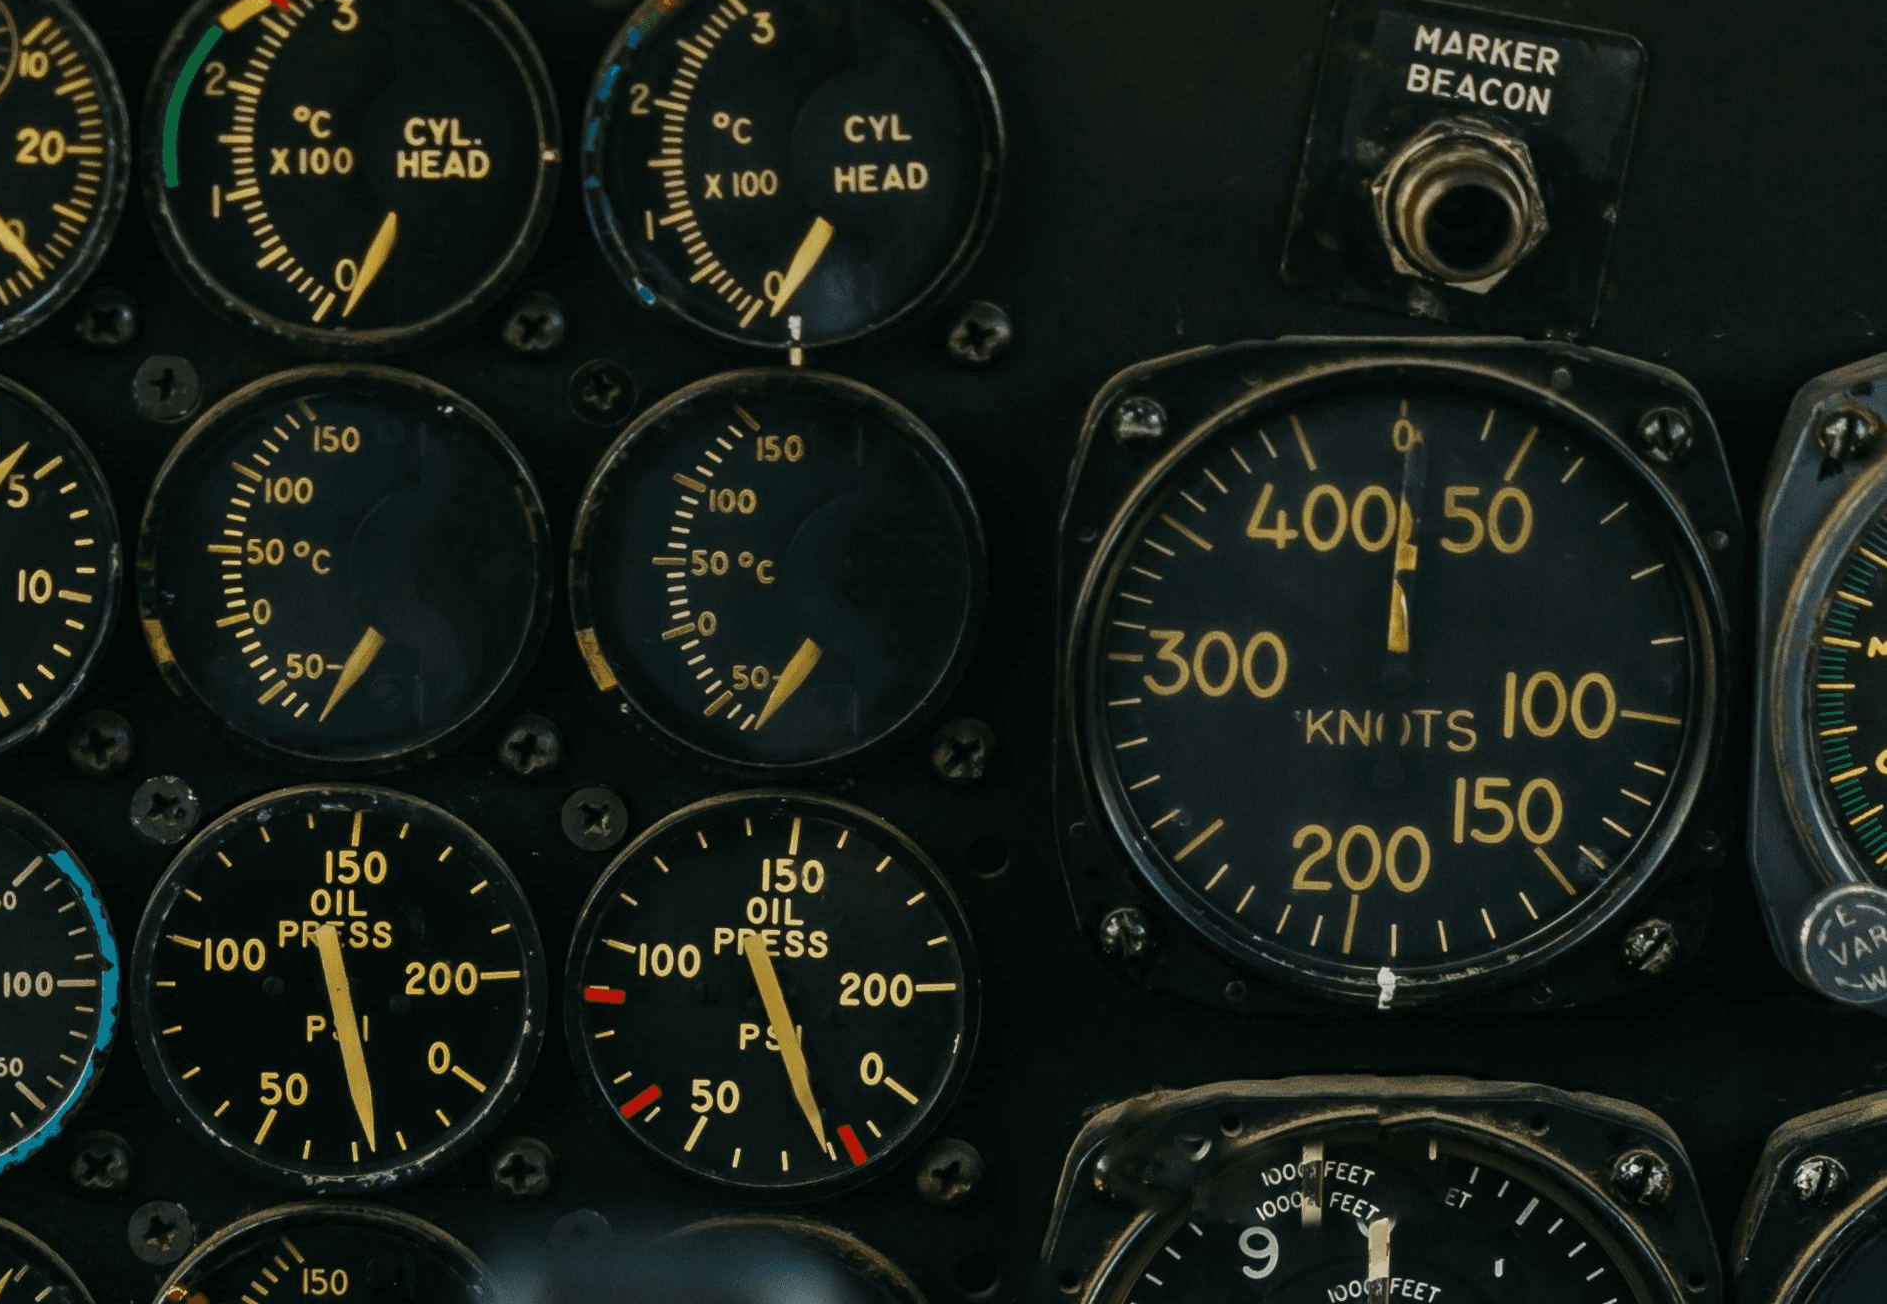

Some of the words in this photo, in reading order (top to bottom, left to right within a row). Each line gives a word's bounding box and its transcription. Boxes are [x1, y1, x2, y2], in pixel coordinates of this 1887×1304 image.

[1413, 24, 1560, 76] MARKER
[204, 61, 227, 97] 2
[1406, 62, 1552, 116] BEACON
[844, 114, 913, 142] CYL
[16, 127, 66, 165] 20
[397, 150, 491, 179] HEAD
[834, 162, 929, 193] HEAD
[313, 425, 361, 452] 150
[756, 435, 804, 462] 150
[265, 477, 314, 504] 100
[709, 488, 758, 514] 100
[1245, 483, 1397, 552] 400
[1439, 485, 1534, 554] 50
[246, 538, 285, 565] 50
[252, 598, 272, 625] 0
[1142, 629, 1289, 698] 300
[1504, 670, 1616, 740] 100
[1304, 708, 1478, 752] KNOTS
[1454, 776, 1564, 844] 150
[324, 850, 388, 884] 150
[761, 858, 825, 893] 150
[1292, 824, 1431, 893] 200
[310, 889, 367, 917] OIL
[746, 897, 804, 926] OIL
[204, 938, 266, 972] 100
[714, 928, 828, 959] PRESS
[3, 972, 54, 998] 100
[405, 961, 478, 996] 200
[259, 1071, 309, 1107] 50
[1324, 1161, 1376, 1186] FEET
[1238, 1227, 1279, 1279] 9
[302, 1268, 349, 1296] 150
[1390, 1277, 1441, 1303] FEET
